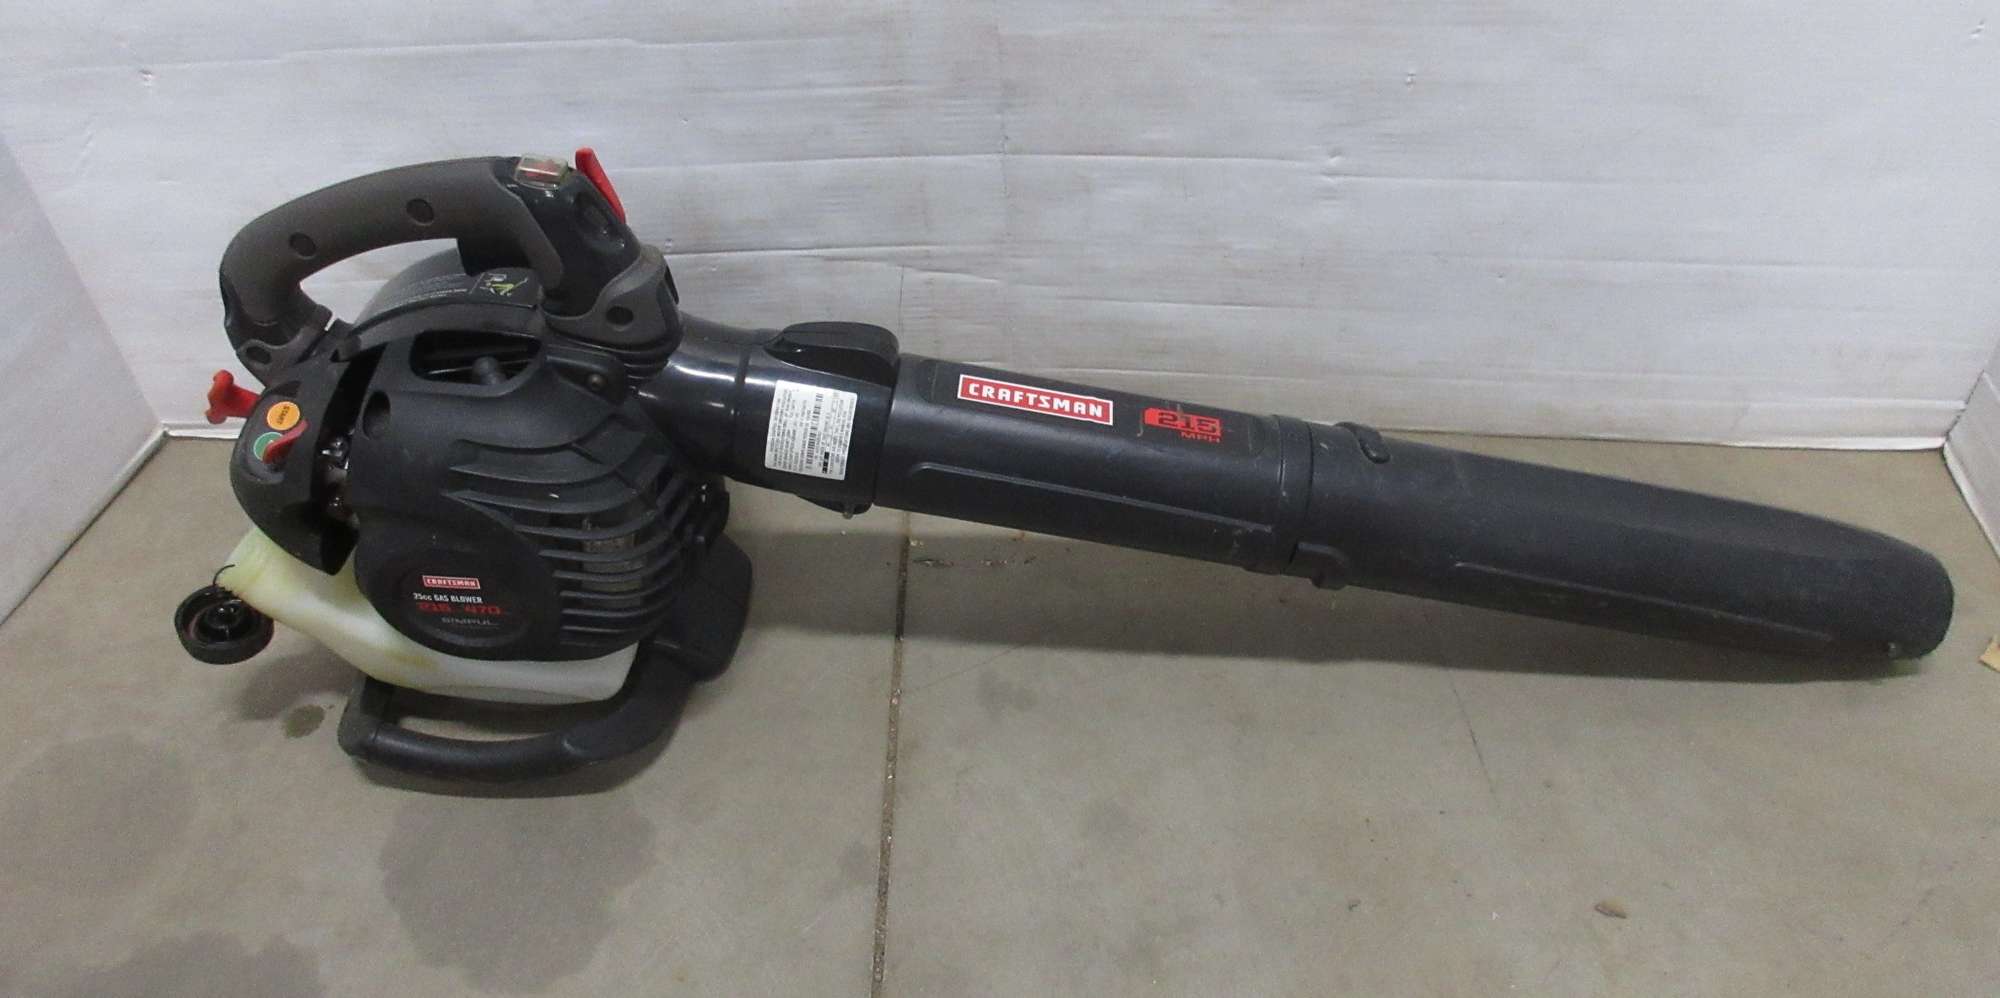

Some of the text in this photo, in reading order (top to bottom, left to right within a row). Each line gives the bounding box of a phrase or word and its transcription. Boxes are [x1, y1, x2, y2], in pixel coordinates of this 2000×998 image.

[967, 382, 1103, 419] CRAFTSMAN
[1157, 411, 1217, 433] 215
[1181, 431, 1220, 443] MPH
[425, 578, 477, 587] CRAFTSMAN
[433, 594, 449, 602] GAS
[450, 595, 483, 604] BLOWER
